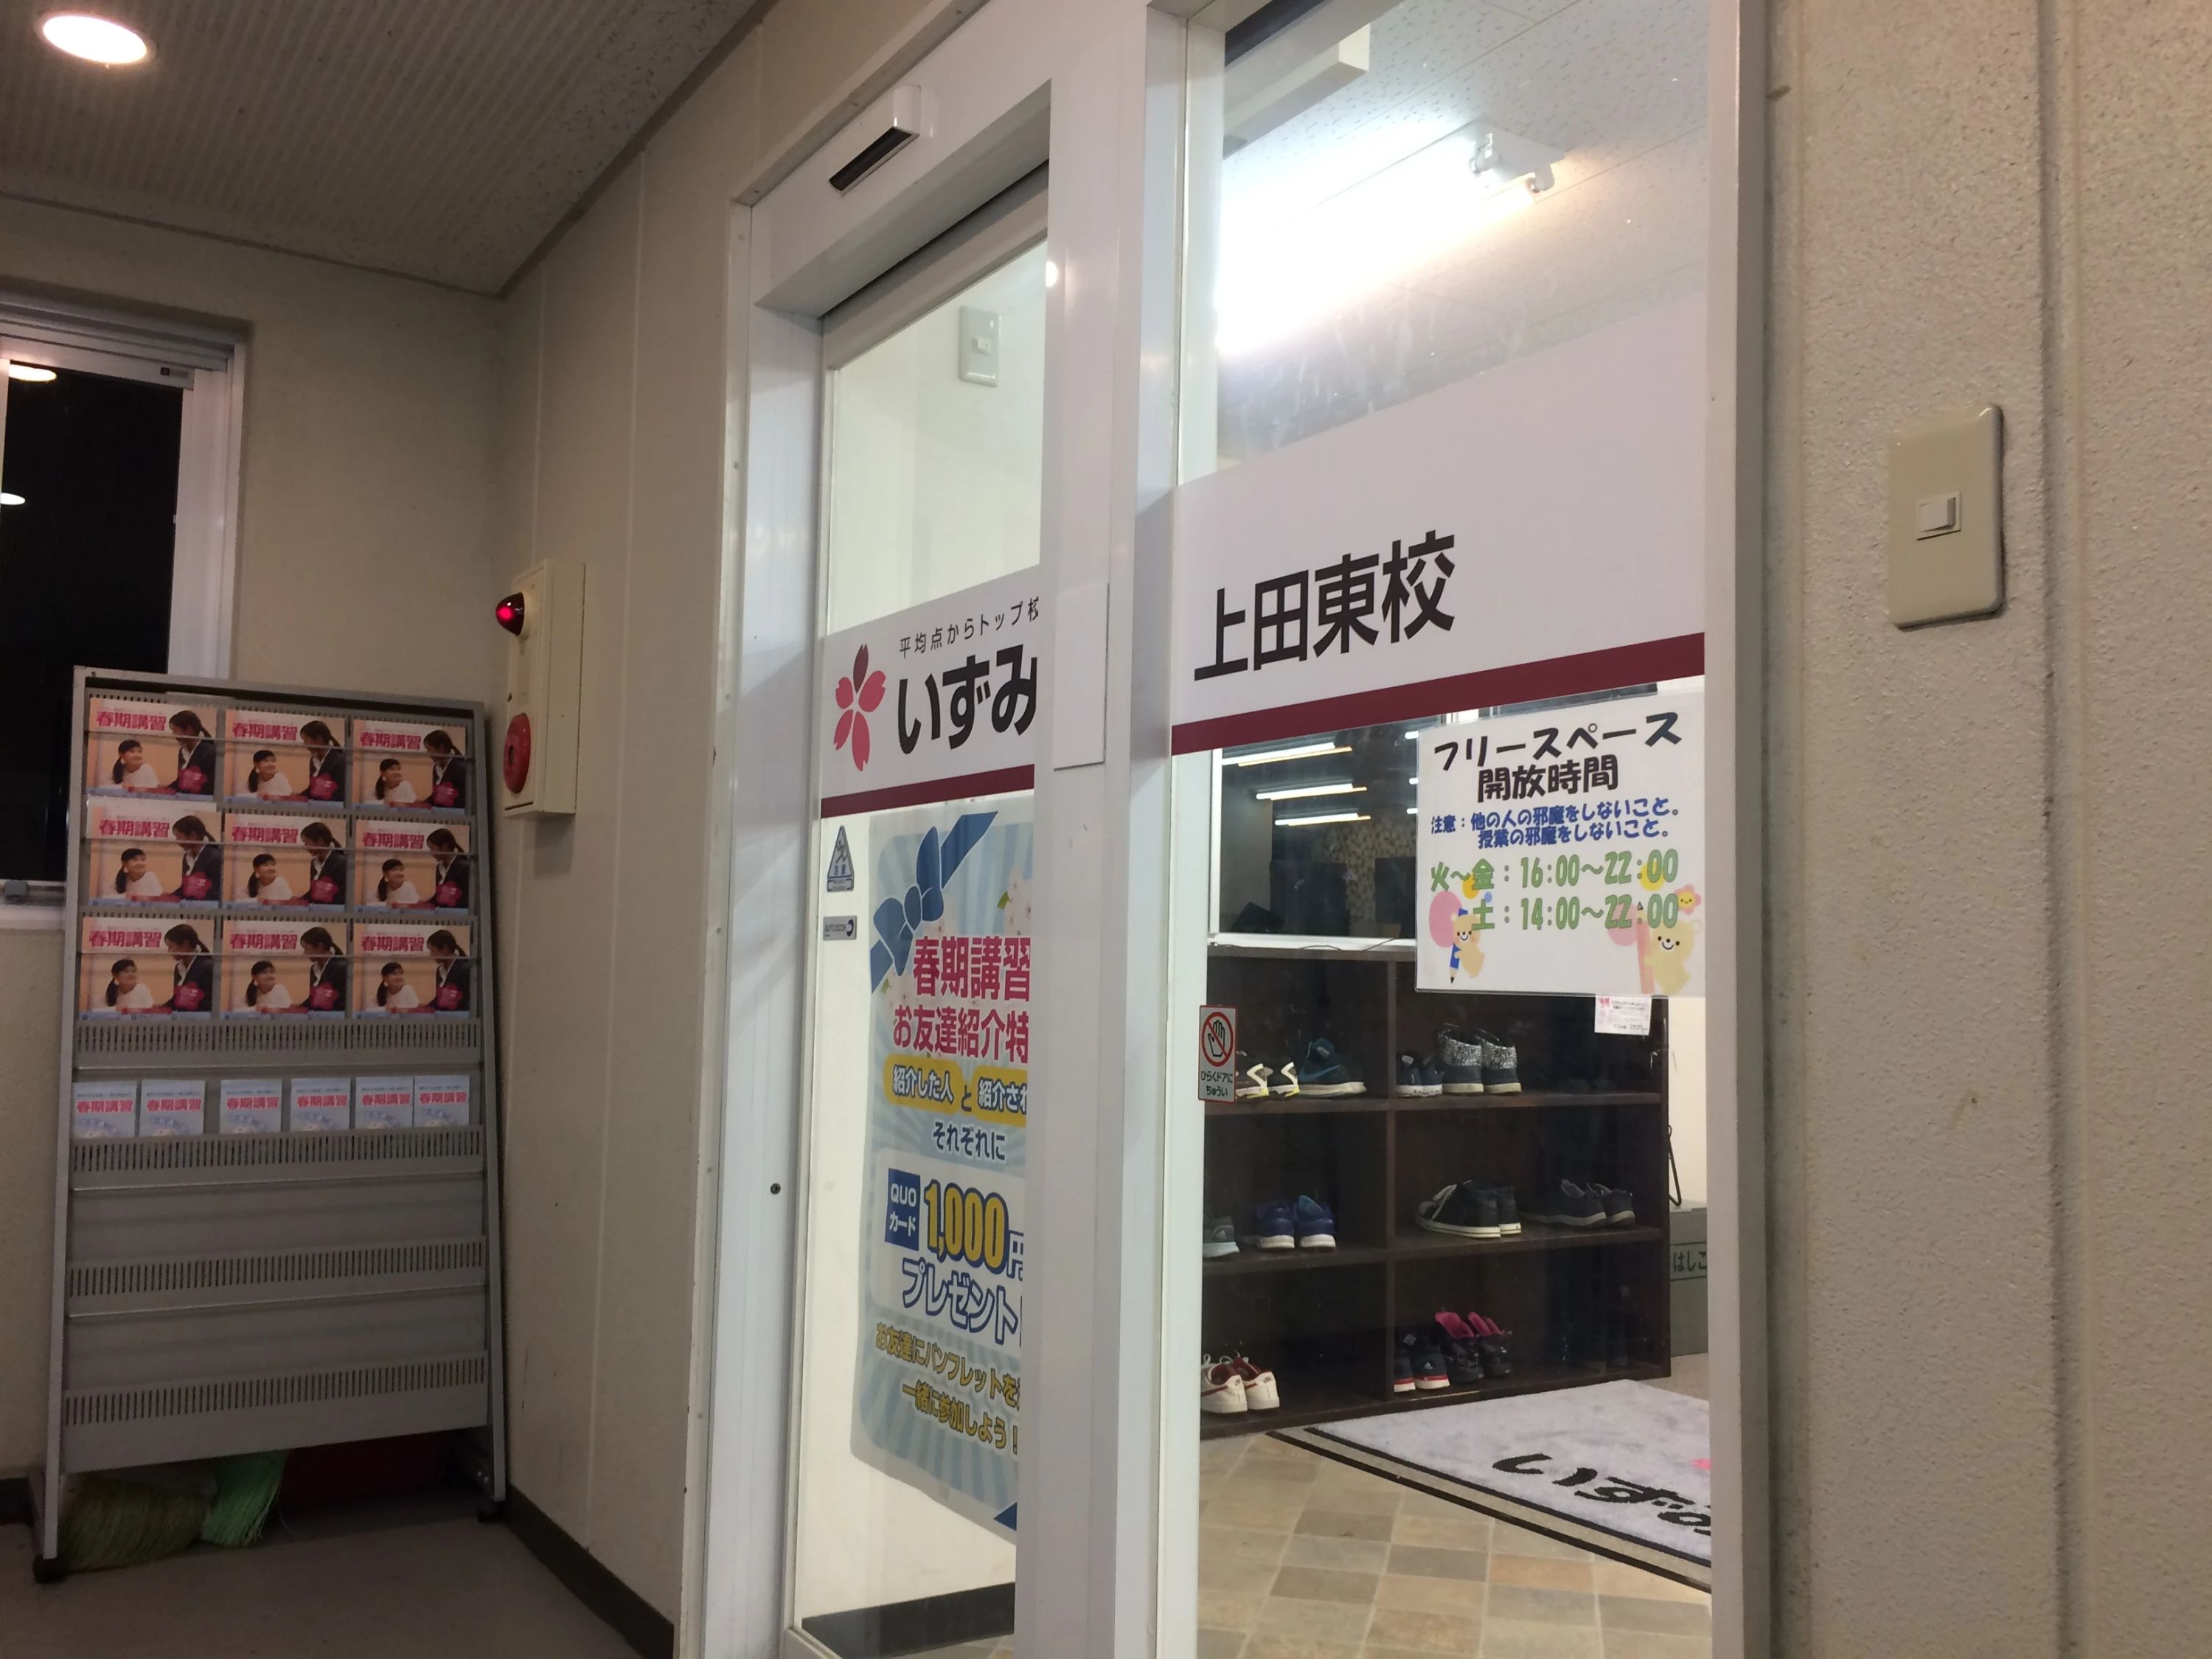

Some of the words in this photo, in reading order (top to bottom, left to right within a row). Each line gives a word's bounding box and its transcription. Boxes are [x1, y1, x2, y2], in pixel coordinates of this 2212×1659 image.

[1194, 529, 1455, 681] 上田東校
[898, 644, 1037, 754] いずみ
[96, 712, 166, 731] 春期講習
[232, 722, 298, 741] 春期講習
[359, 731, 422, 750] 春期講習
[1434, 712, 1683, 771] フリースペース
[1477, 754, 1618, 802] 開放時間
[99, 820, 170, 838] 春期講習
[232, 826, 298, 844] 春期講習
[362, 832, 425, 849] 春期講習
[1478, 818, 1669, 849] 授業の邪魔をしないこと。
[88, 931, 161, 948] 春期講習
[230, 933, 297, 950] 春期講習
[361, 935, 425, 952] 春期講習
[913, 936, 1030, 1002] 春期講習
[894, 1004, 1029, 1064] お友達紹介特
[893, 1065, 953, 1102] 紹介した人
[961, 1085, 972, 1112] と
[1201, 1071, 1233, 1083] ひらくドアに
[1206, 1085, 1228, 1096] ちゅうい
[933, 1121, 1005, 1161] それぞれに
[891, 1183, 917, 1208] QUO
[889, 1214, 917, 1238] カード
[902, 1257, 1022, 1347] プレゼント
